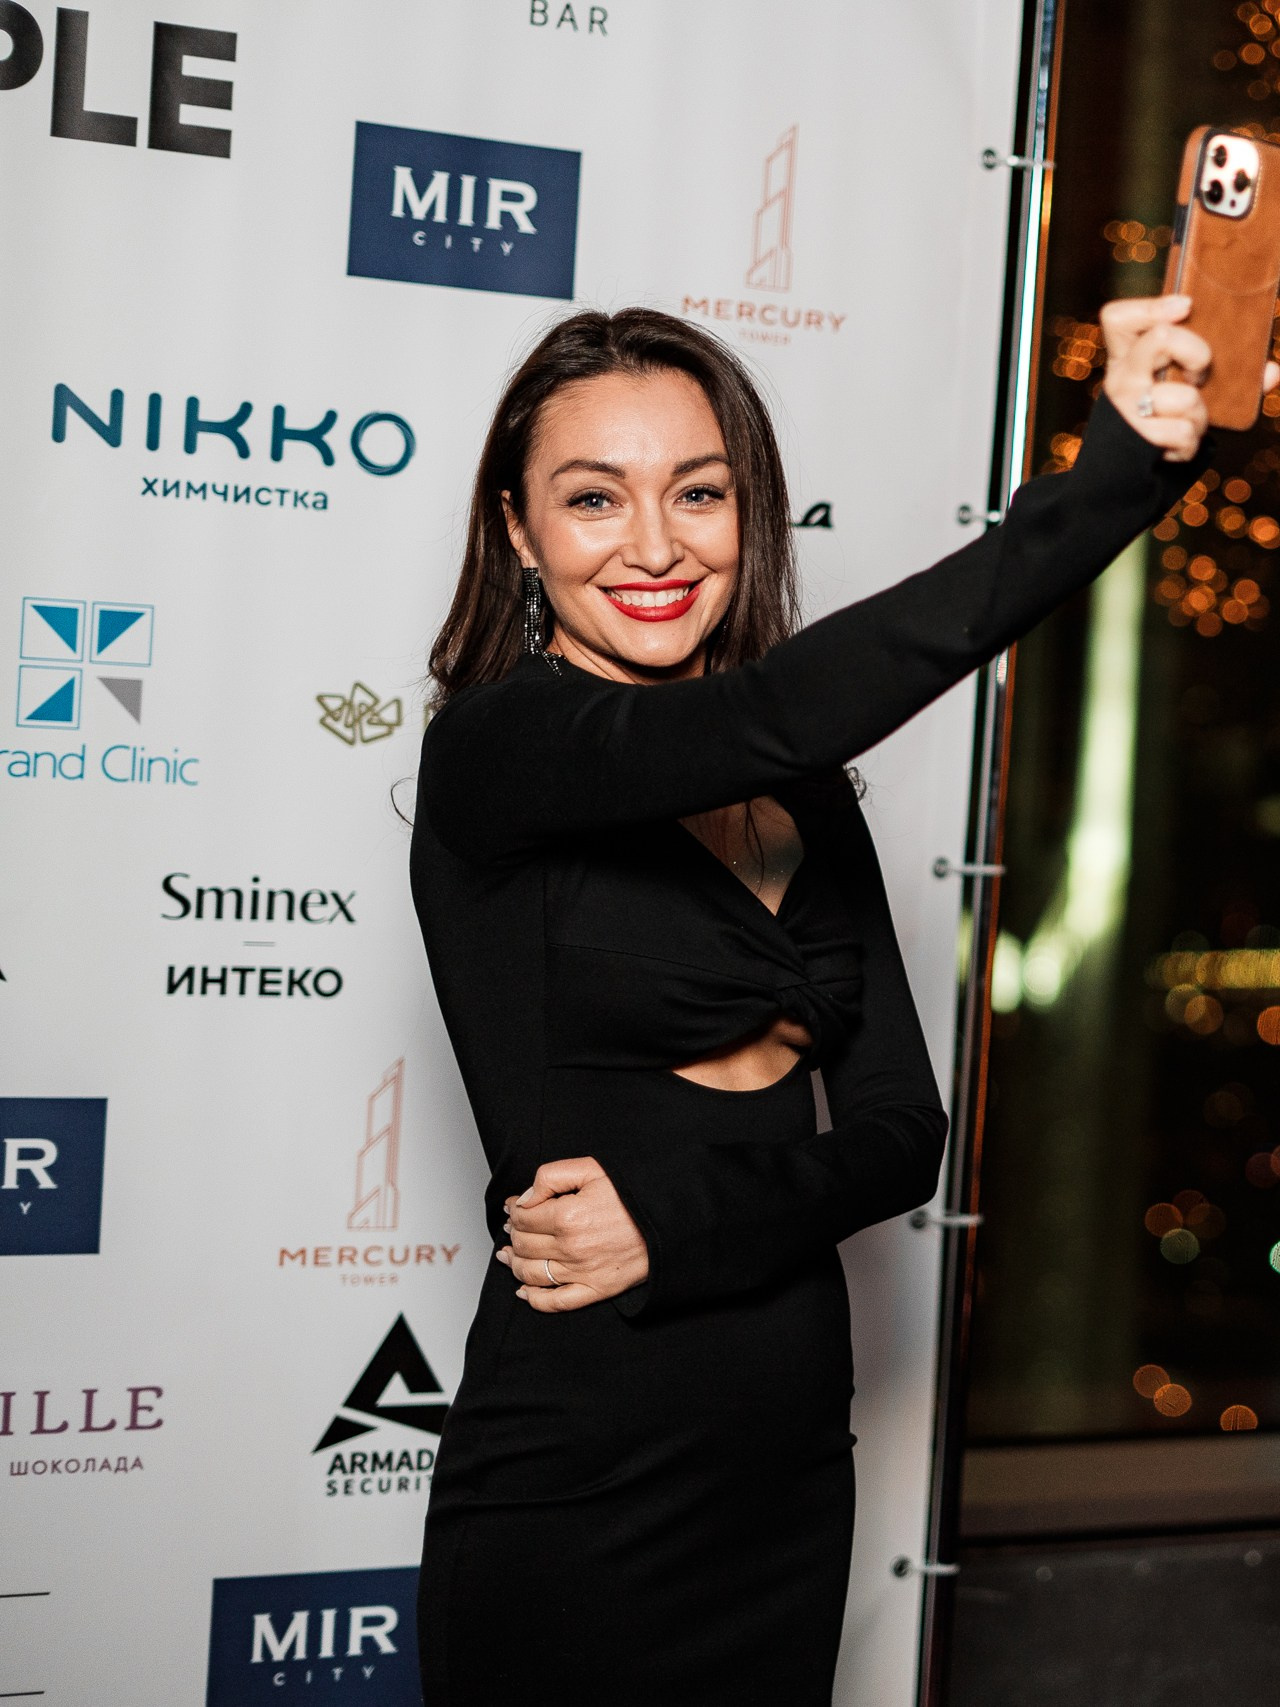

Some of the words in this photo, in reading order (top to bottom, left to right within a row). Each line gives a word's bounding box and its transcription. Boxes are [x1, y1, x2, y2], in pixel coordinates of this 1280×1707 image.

[530, 0, 608, 37] BAR
[390, 165, 539, 235] MIR
[412, 230, 515, 257] CITY
[682, 294, 847, 333] MERCURY
[51, 382, 416, 476] NIKKO
[141, 476, 329, 511] химчистка
[101, 744, 199, 787] Clinic
[161, 872, 357, 924] Sminex
[166, 964, 344, 998] ИНТЕКО
[278, 1243, 461, 1267] MERCURY
[340, 1273, 400, 1287] TOWER
[0, 1385, 164, 1436] ILLE
[9, 1456, 144, 1477] ШОКОЛАДА
[250, 1604, 399, 1664] MIR
[272, 1664, 375, 1687] CITY
